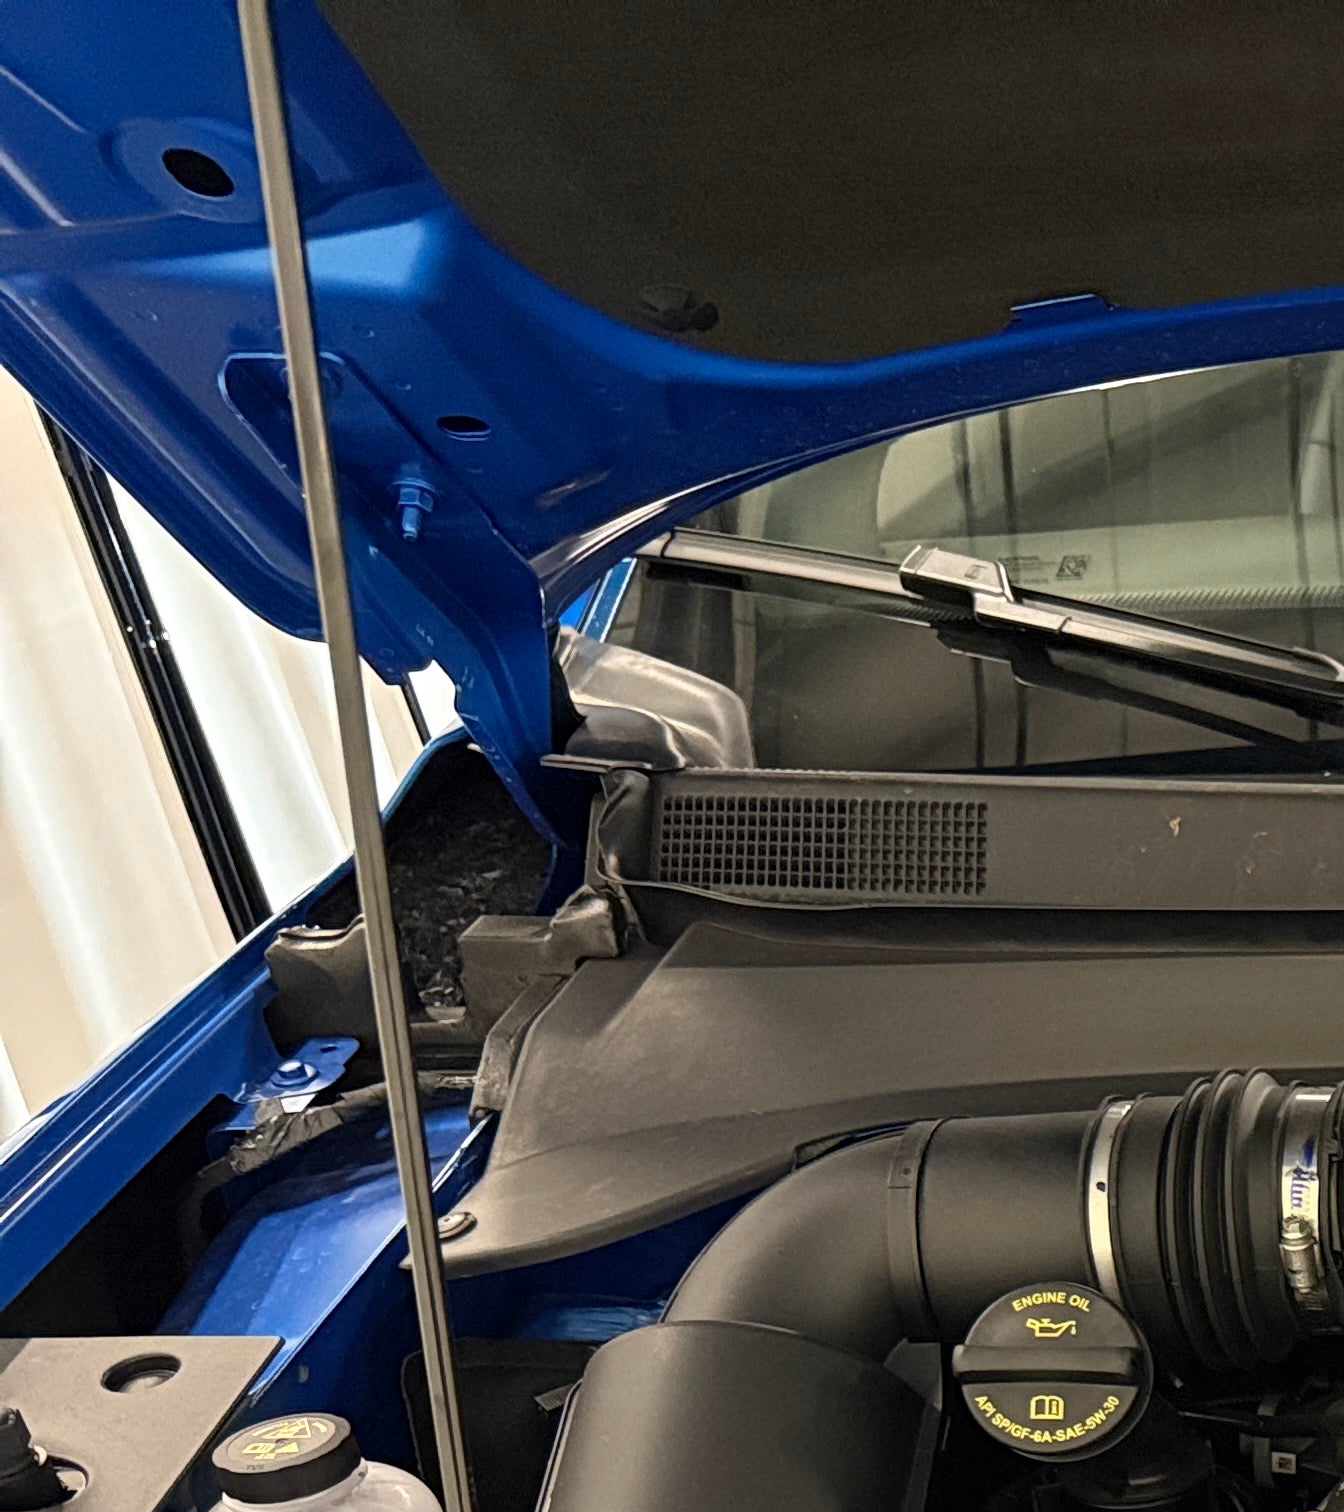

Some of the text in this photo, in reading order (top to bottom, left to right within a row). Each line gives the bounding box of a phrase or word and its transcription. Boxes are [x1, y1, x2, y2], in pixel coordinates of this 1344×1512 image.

[1012, 1292, 1091, 1312] ENGINE OIL
[974, 1395, 997, 1417] API
